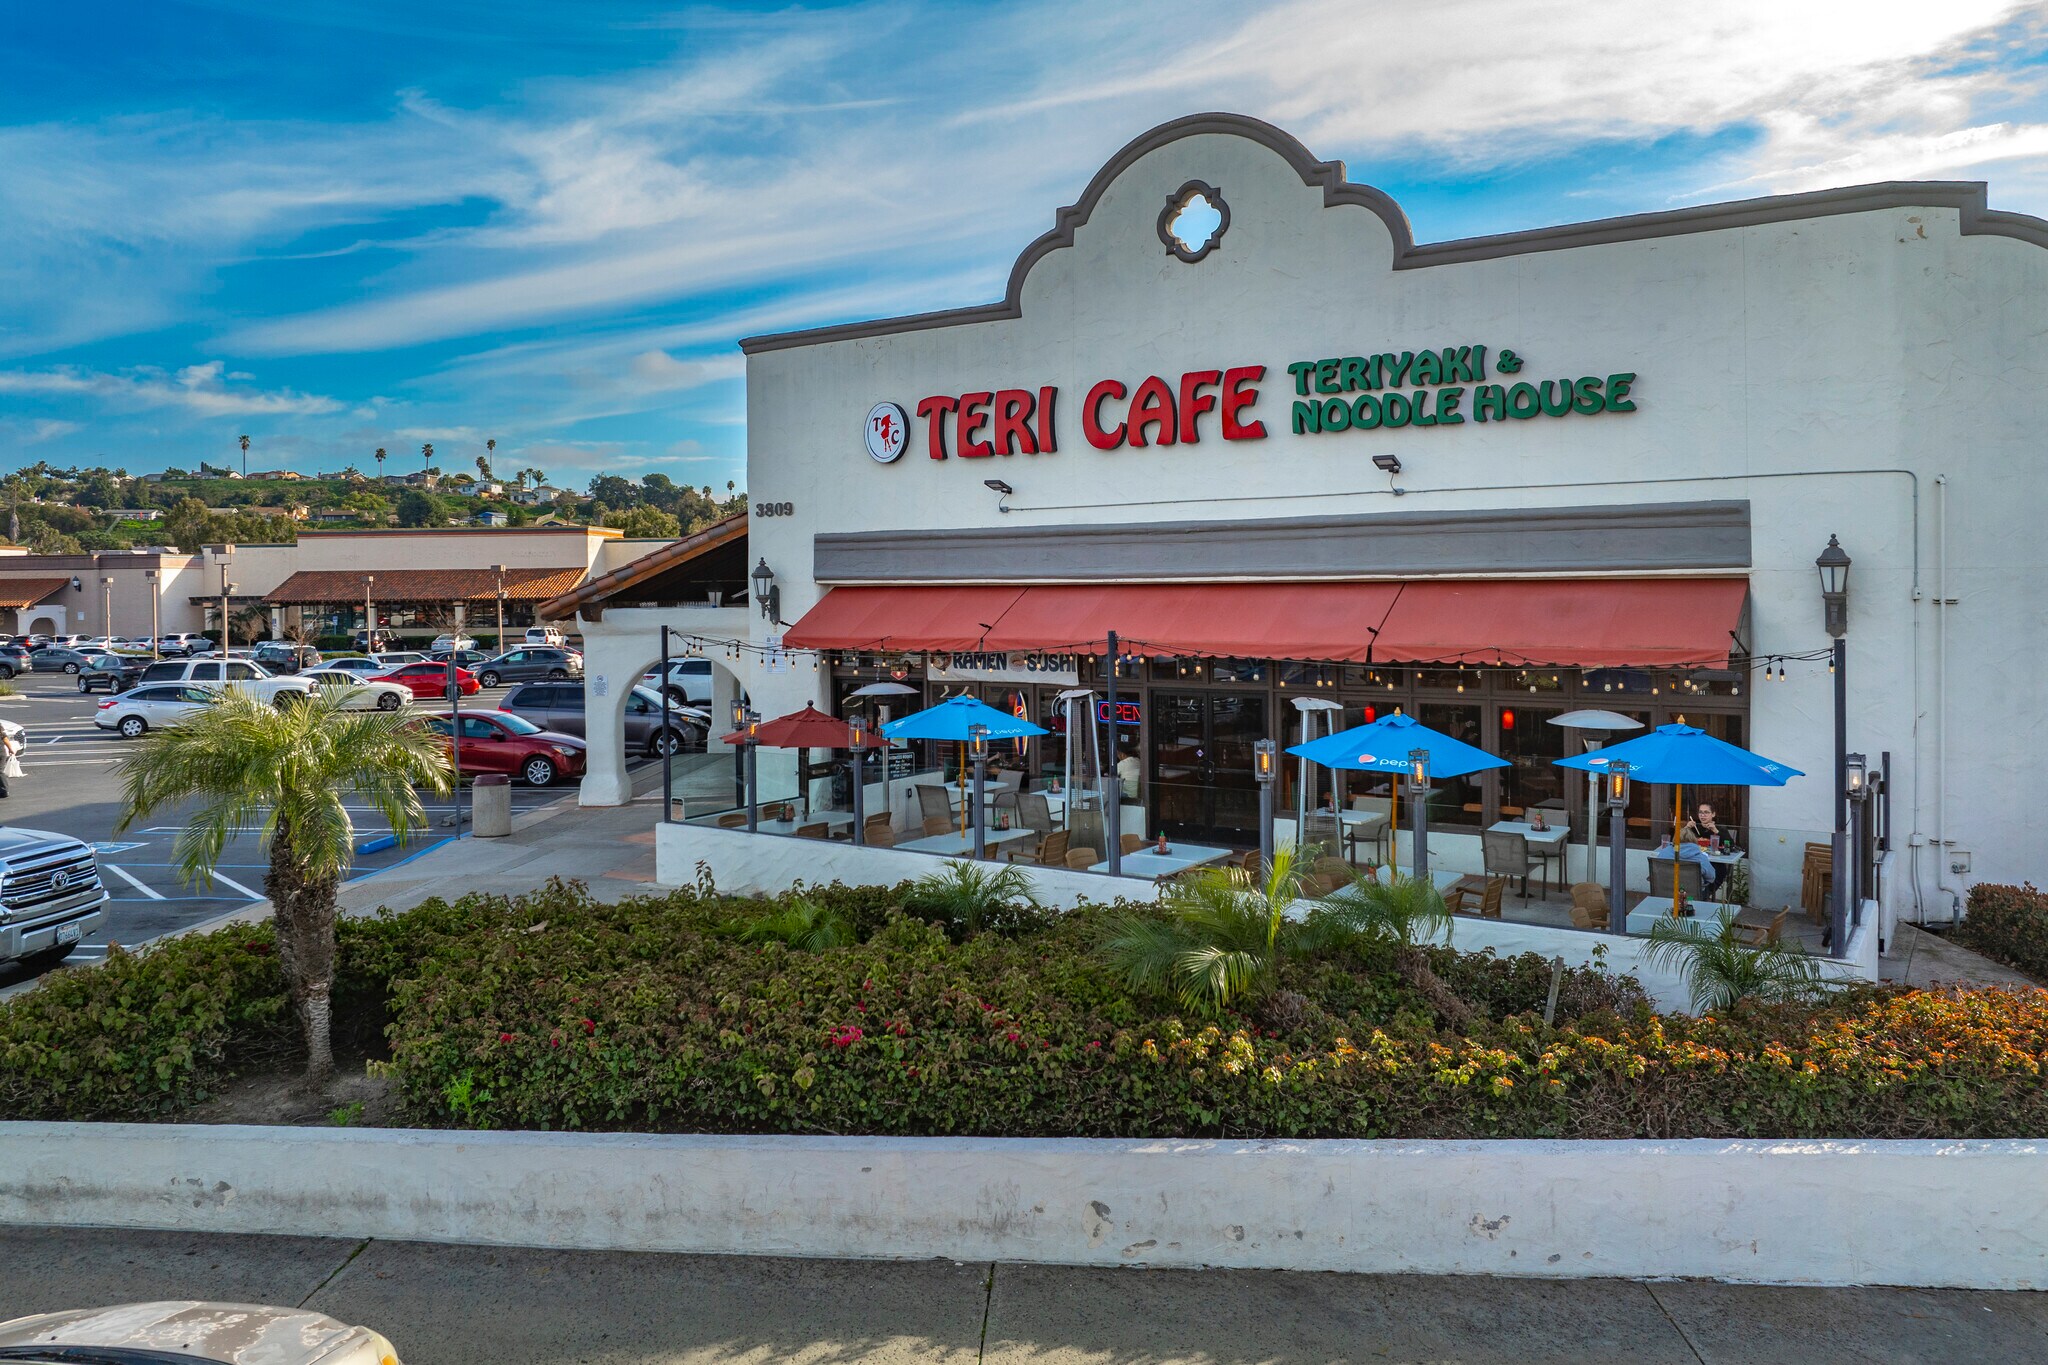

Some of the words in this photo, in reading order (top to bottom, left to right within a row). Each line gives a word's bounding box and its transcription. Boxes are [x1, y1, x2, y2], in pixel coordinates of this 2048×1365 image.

[1287, 345, 1487, 395] TERIYAKI
[1496, 349, 1524, 373] &
[917, 386, 1058, 459] TERI
[1083, 365, 1268, 450] CAFE
[1292, 387, 1465, 434] NOODLE
[1473, 372, 1637, 422] HOUSE
[872, 417, 881, 432] T
[891, 429, 900, 444] C
[755, 501, 794, 517] 3809
[953, 652, 1007, 670] RAMEN
[1027, 653, 1076, 672] SUSHI
